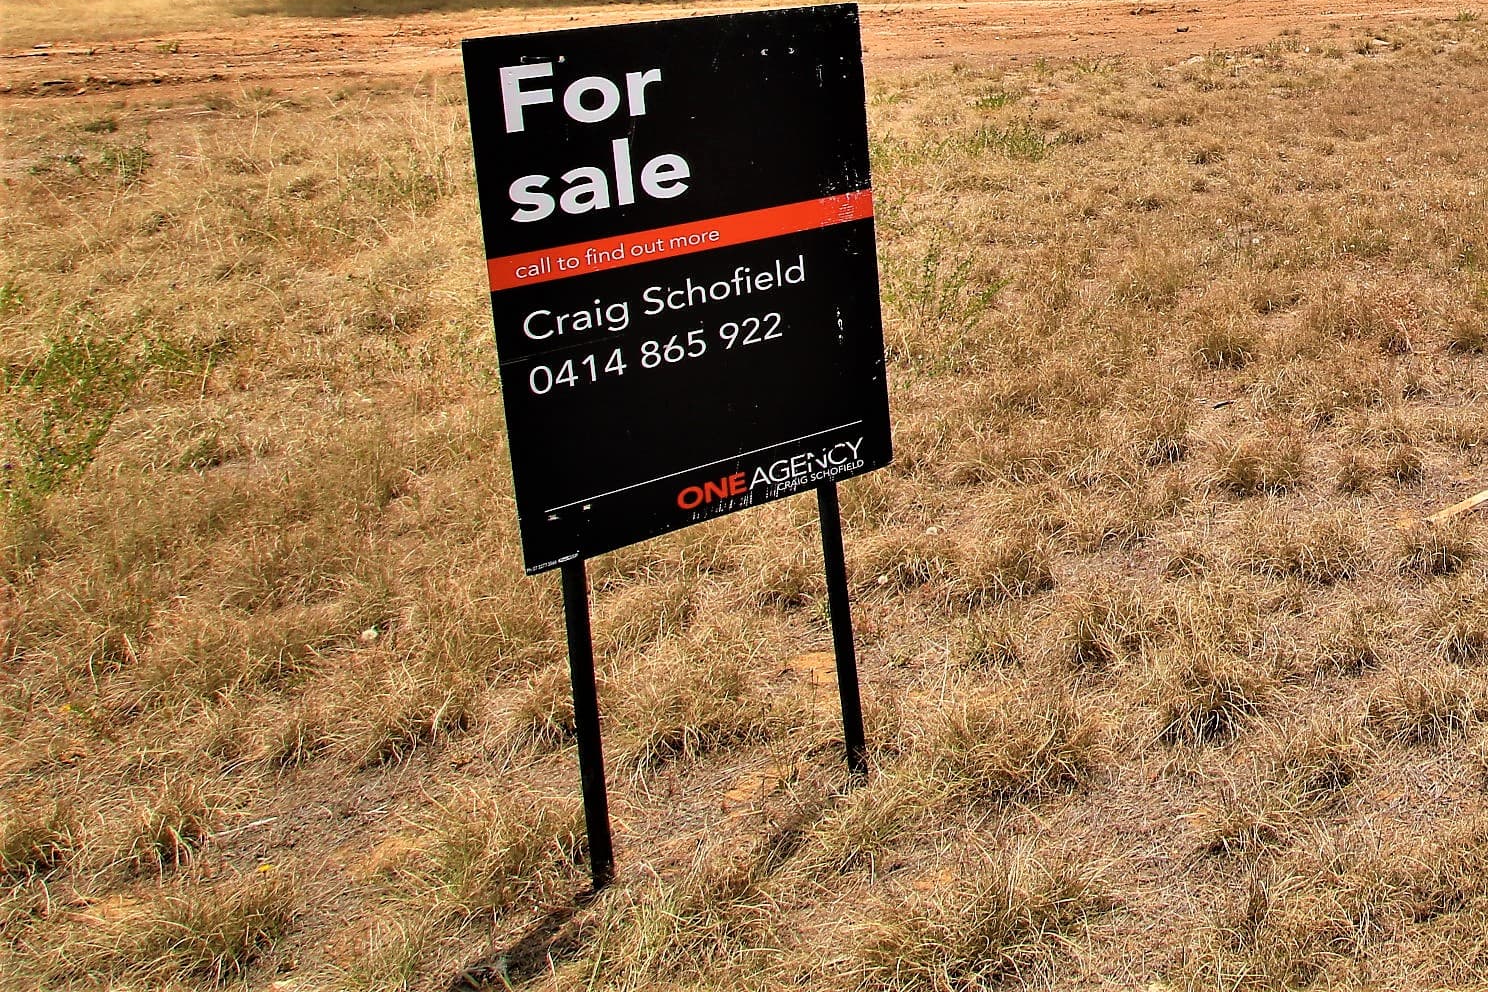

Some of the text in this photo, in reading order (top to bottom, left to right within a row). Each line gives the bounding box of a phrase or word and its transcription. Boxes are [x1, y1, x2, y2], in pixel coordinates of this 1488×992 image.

[500, 62, 662, 133] For
[508, 137, 691, 223] sale
[515, 229, 720, 279] call to find out more
[523, 254, 807, 341] Craig Schofield
[529, 311, 783, 396] 0414 865 922
[677, 436, 864, 510] ONE AGENCY
[777, 459, 865, 492] CRAIG SCHOFIELD
